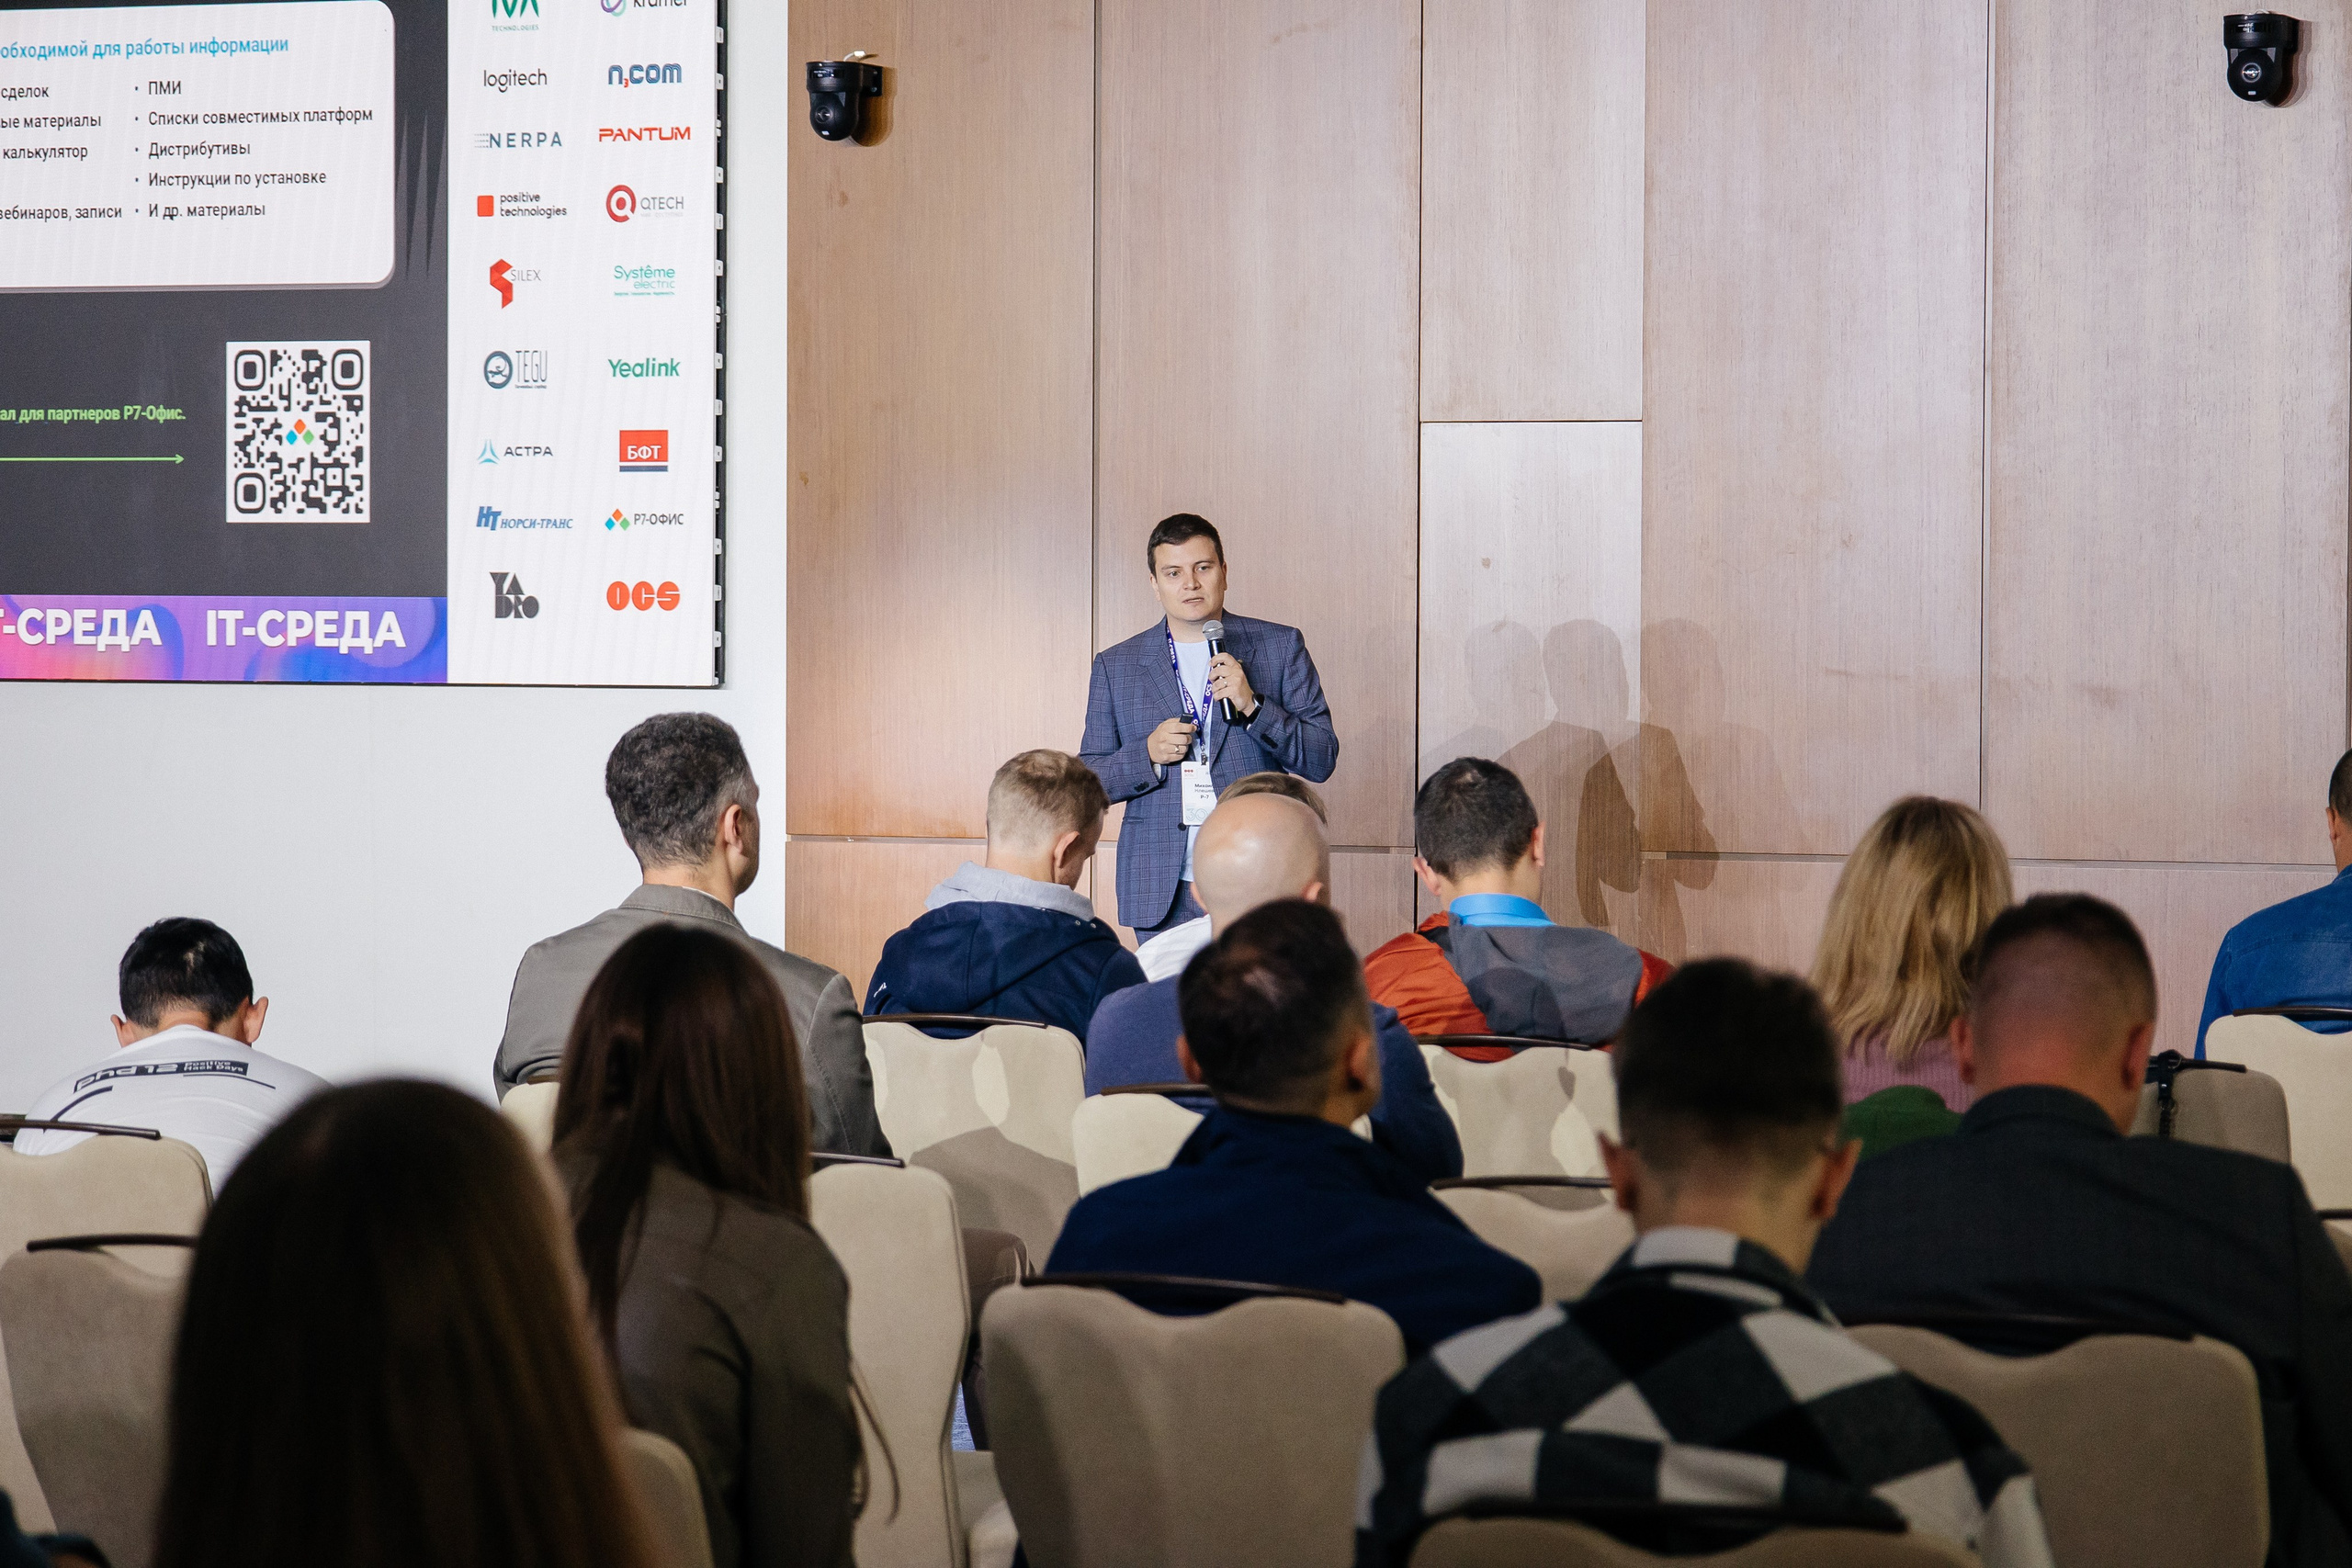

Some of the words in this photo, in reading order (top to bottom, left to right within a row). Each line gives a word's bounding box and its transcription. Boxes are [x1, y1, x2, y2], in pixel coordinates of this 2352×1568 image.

[0, 40, 87, 61] обходимой
[93, 44, 120, 59] для
[126, 39, 184, 59] работы
[190, 37, 288, 57] информации
[149, 81, 181, 95] ПМИ
[484, 69, 547, 93] logitech
[1, 87, 49, 101] сделок
[0, 118, 19, 128] ые
[24, 116, 101, 130] материалы
[149, 111, 198, 125] Списки
[203, 112, 300, 124] совместимых
[304, 107, 372, 125] платформ
[490, 132, 561, 148] NERPA
[599, 127, 690, 141] PANTUM
[4, 147, 87, 162] калькулятор
[149, 141, 250, 159] Дистрибутивы
[150, 173, 230, 189] Инструкции
[235, 175, 251, 185] по
[255, 173, 326, 188] установке
[501, 192, 540, 205] positive
[640, 197, 684, 209] QTECH
[75, 208, 121, 219] записи
[150, 204, 158, 217] И
[163, 207, 182, 220] др.
[187, 205, 265, 220] материалы
[501, 206, 567, 219] technologies
[515, 351, 548, 382] TEGU
[608, 358, 680, 378] Yealink
[0, 409, 17, 421] ал
[18, 409, 44, 423] для
[48, 409, 120, 424] партнеров
[124, 404, 186, 423] Р7-Офис.
[504, 446, 553, 457] АСТРА
[627, 445, 662, 459] БФТ
[501, 518, 573, 529] НОРСИ-ТРАНС
[634, 513, 684, 525] Р7-ОФИС
[606, 581, 680, 611] OCS
[206, 609, 406, 654] IT-СРЕДА
